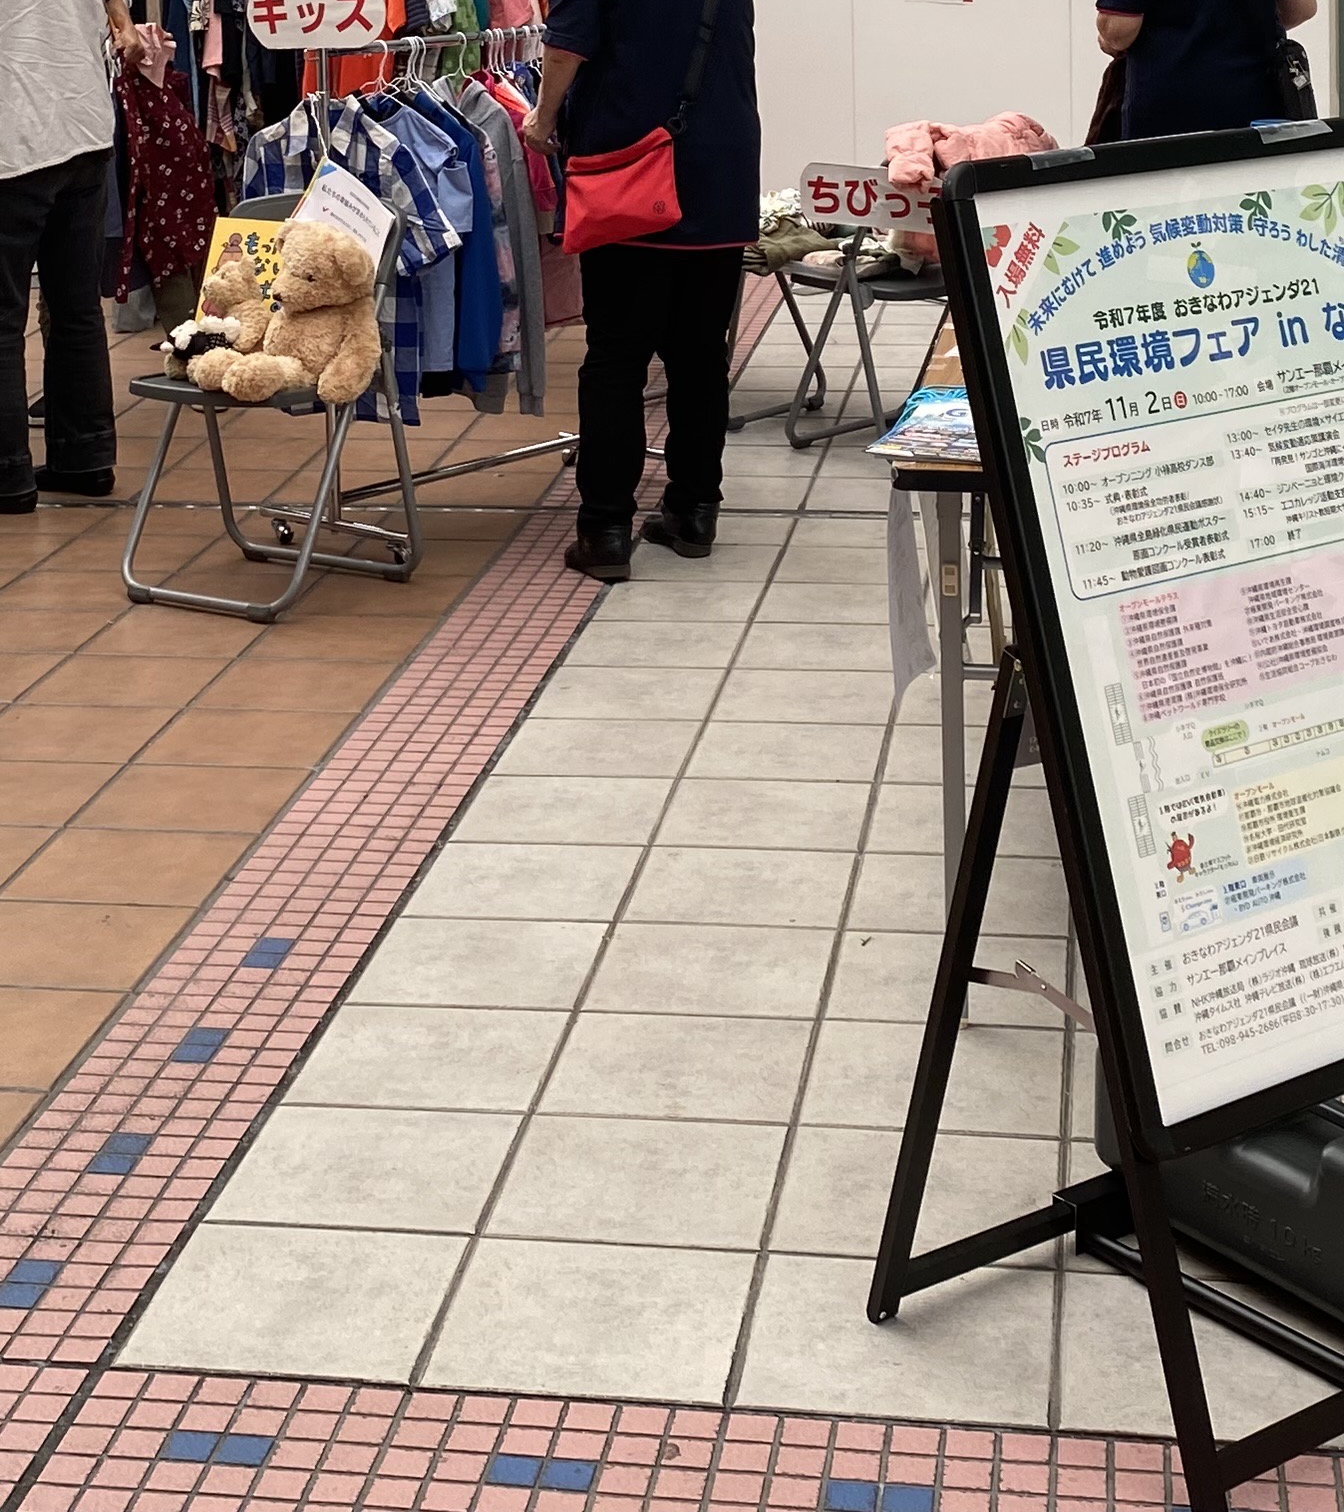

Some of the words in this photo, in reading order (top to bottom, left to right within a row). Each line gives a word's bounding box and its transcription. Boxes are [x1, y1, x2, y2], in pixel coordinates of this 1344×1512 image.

[996, 222, 1045, 308] 入場無料
[1027, 259, 1097, 336] 未来にむけて
[1095, 229, 1147, 272] 進めよう
[1148, 212, 1246, 247] 気候変動対策
[1251, 215, 1294, 245] 守ろう
[1091, 300, 1167, 332] 令和7年度
[1171, 276, 1320, 318] おきなわアジェンダ21
[1037, 312, 1266, 392] 県民環境フェア
[1275, 308, 1310, 348] in
[1040, 417, 1060, 432] 日時
[1062, 407, 1104, 429] 令和7年
[1103, 393, 1140, 422] 11月
[1143, 387, 1172, 415] 2日
[1255, 379, 1274, 392] 会場
[1061, 438, 1151, 468] ステージプログラム
[1249, 534, 1276, 550] 17:00
[1286, 527, 1303, 542] 終了
